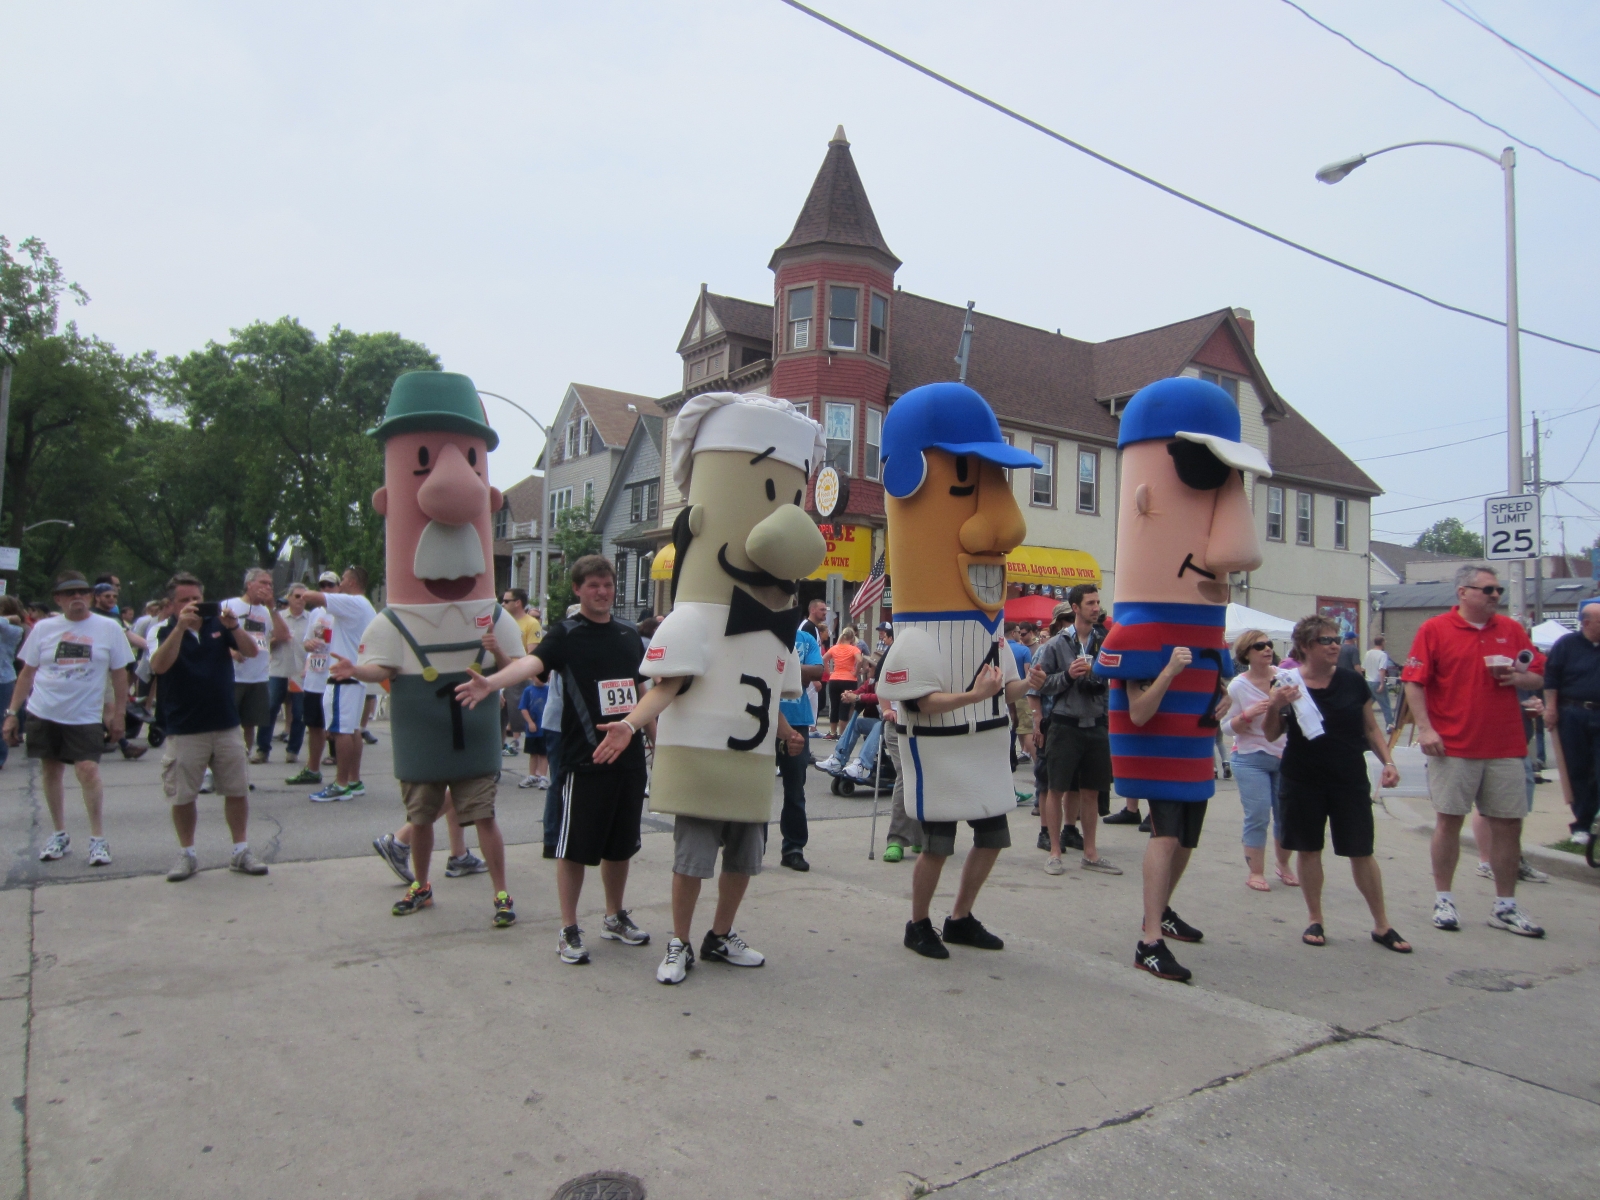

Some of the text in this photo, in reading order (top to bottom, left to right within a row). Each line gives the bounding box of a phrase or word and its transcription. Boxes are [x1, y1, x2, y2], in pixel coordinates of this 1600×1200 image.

[1491, 501, 1533, 514] SPEED
[1496, 512, 1528, 525] LIMIT
[1491, 528, 1533, 554] 25
[830, 556, 850, 568] WINE
[1006, 561, 1096, 579] BEER, LIQUOR, AND WINE
[606, 687, 634, 706] 934
[1198, 647, 1222, 728] 2
[726, 672, 772, 752] 3
